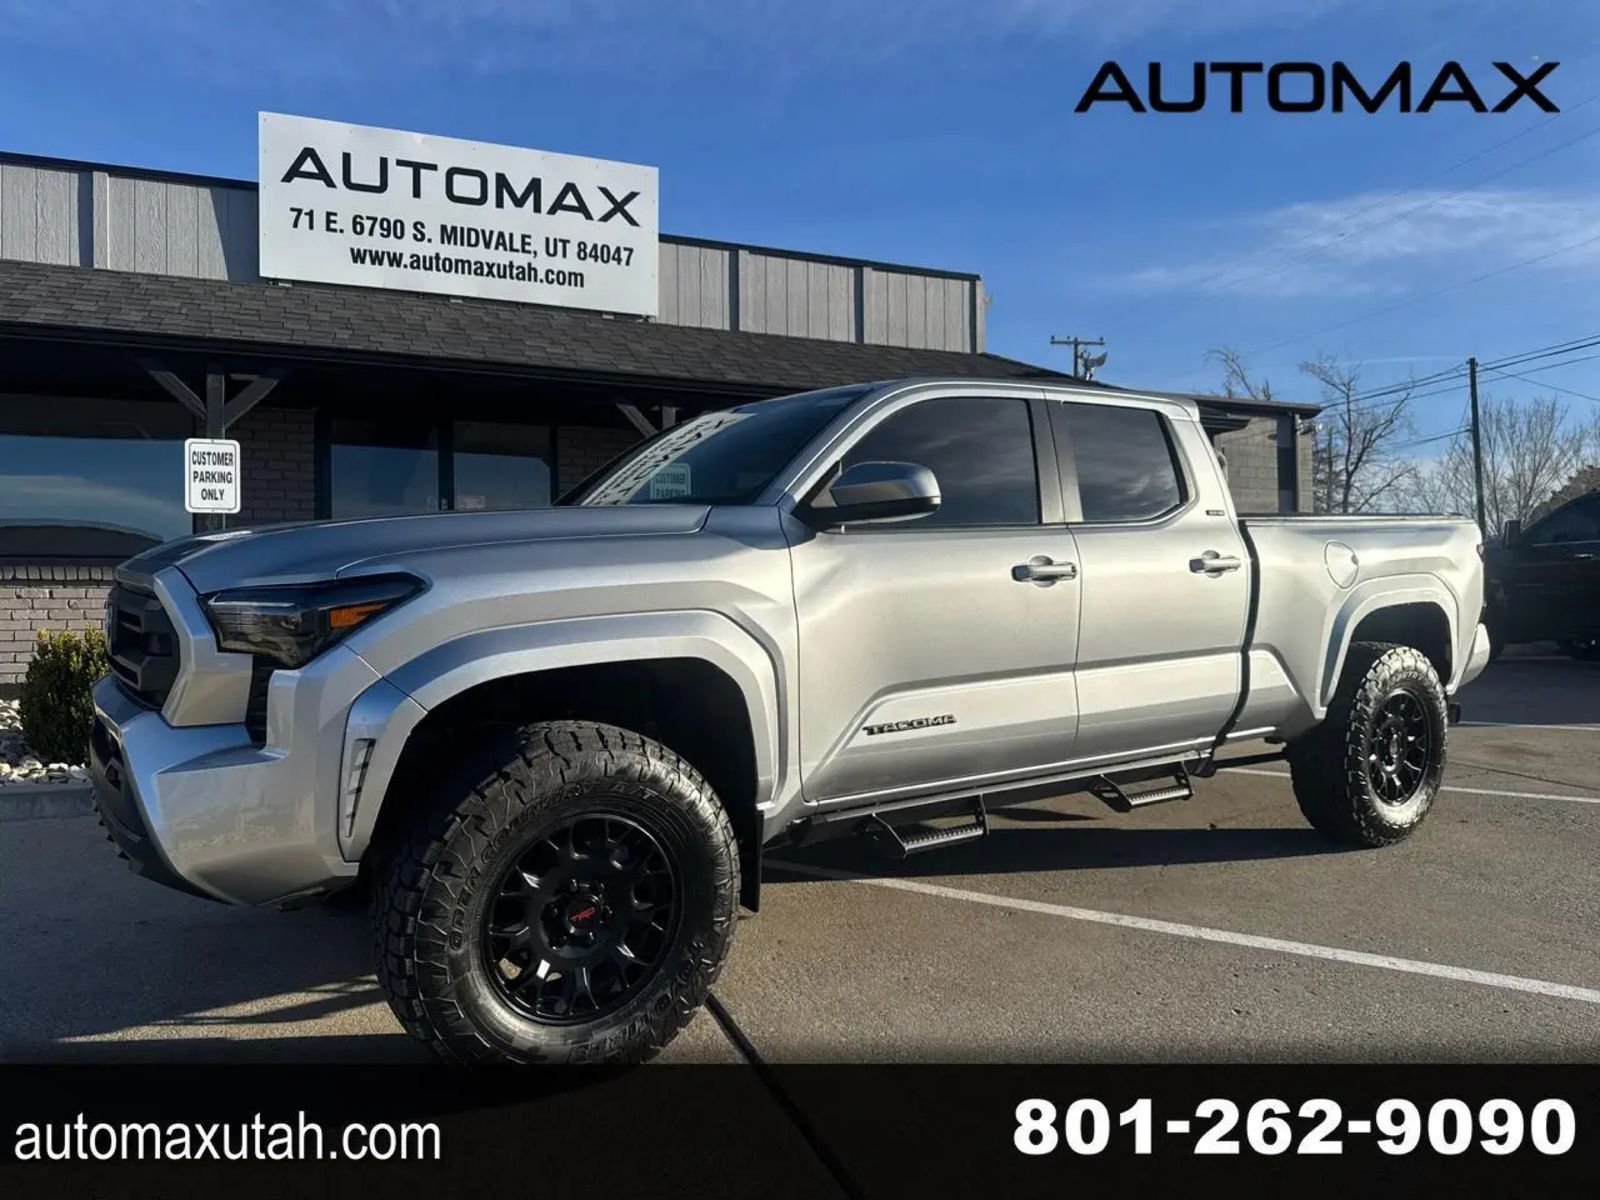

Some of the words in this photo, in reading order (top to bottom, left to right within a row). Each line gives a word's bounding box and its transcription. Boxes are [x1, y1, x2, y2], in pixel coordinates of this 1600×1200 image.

[280, 146, 641, 227] AUTOMAX
[289, 206, 315, 231] 71
[325, 210, 345, 234] E.
[352, 214, 405, 240] 6790
[412, 220, 432, 243] S.
[440, 223, 538, 259] MIDVALE,
[545, 236, 571, 259] UT
[577, 241, 635, 267] 84047
[350, 246, 585, 289] www.automaxutah.com
[192, 450, 234, 467] CUSTOMER
[193, 470, 233, 484] PARKING
[201, 488, 225, 501] ONLY
[862, 714, 957, 736] TACOMA
